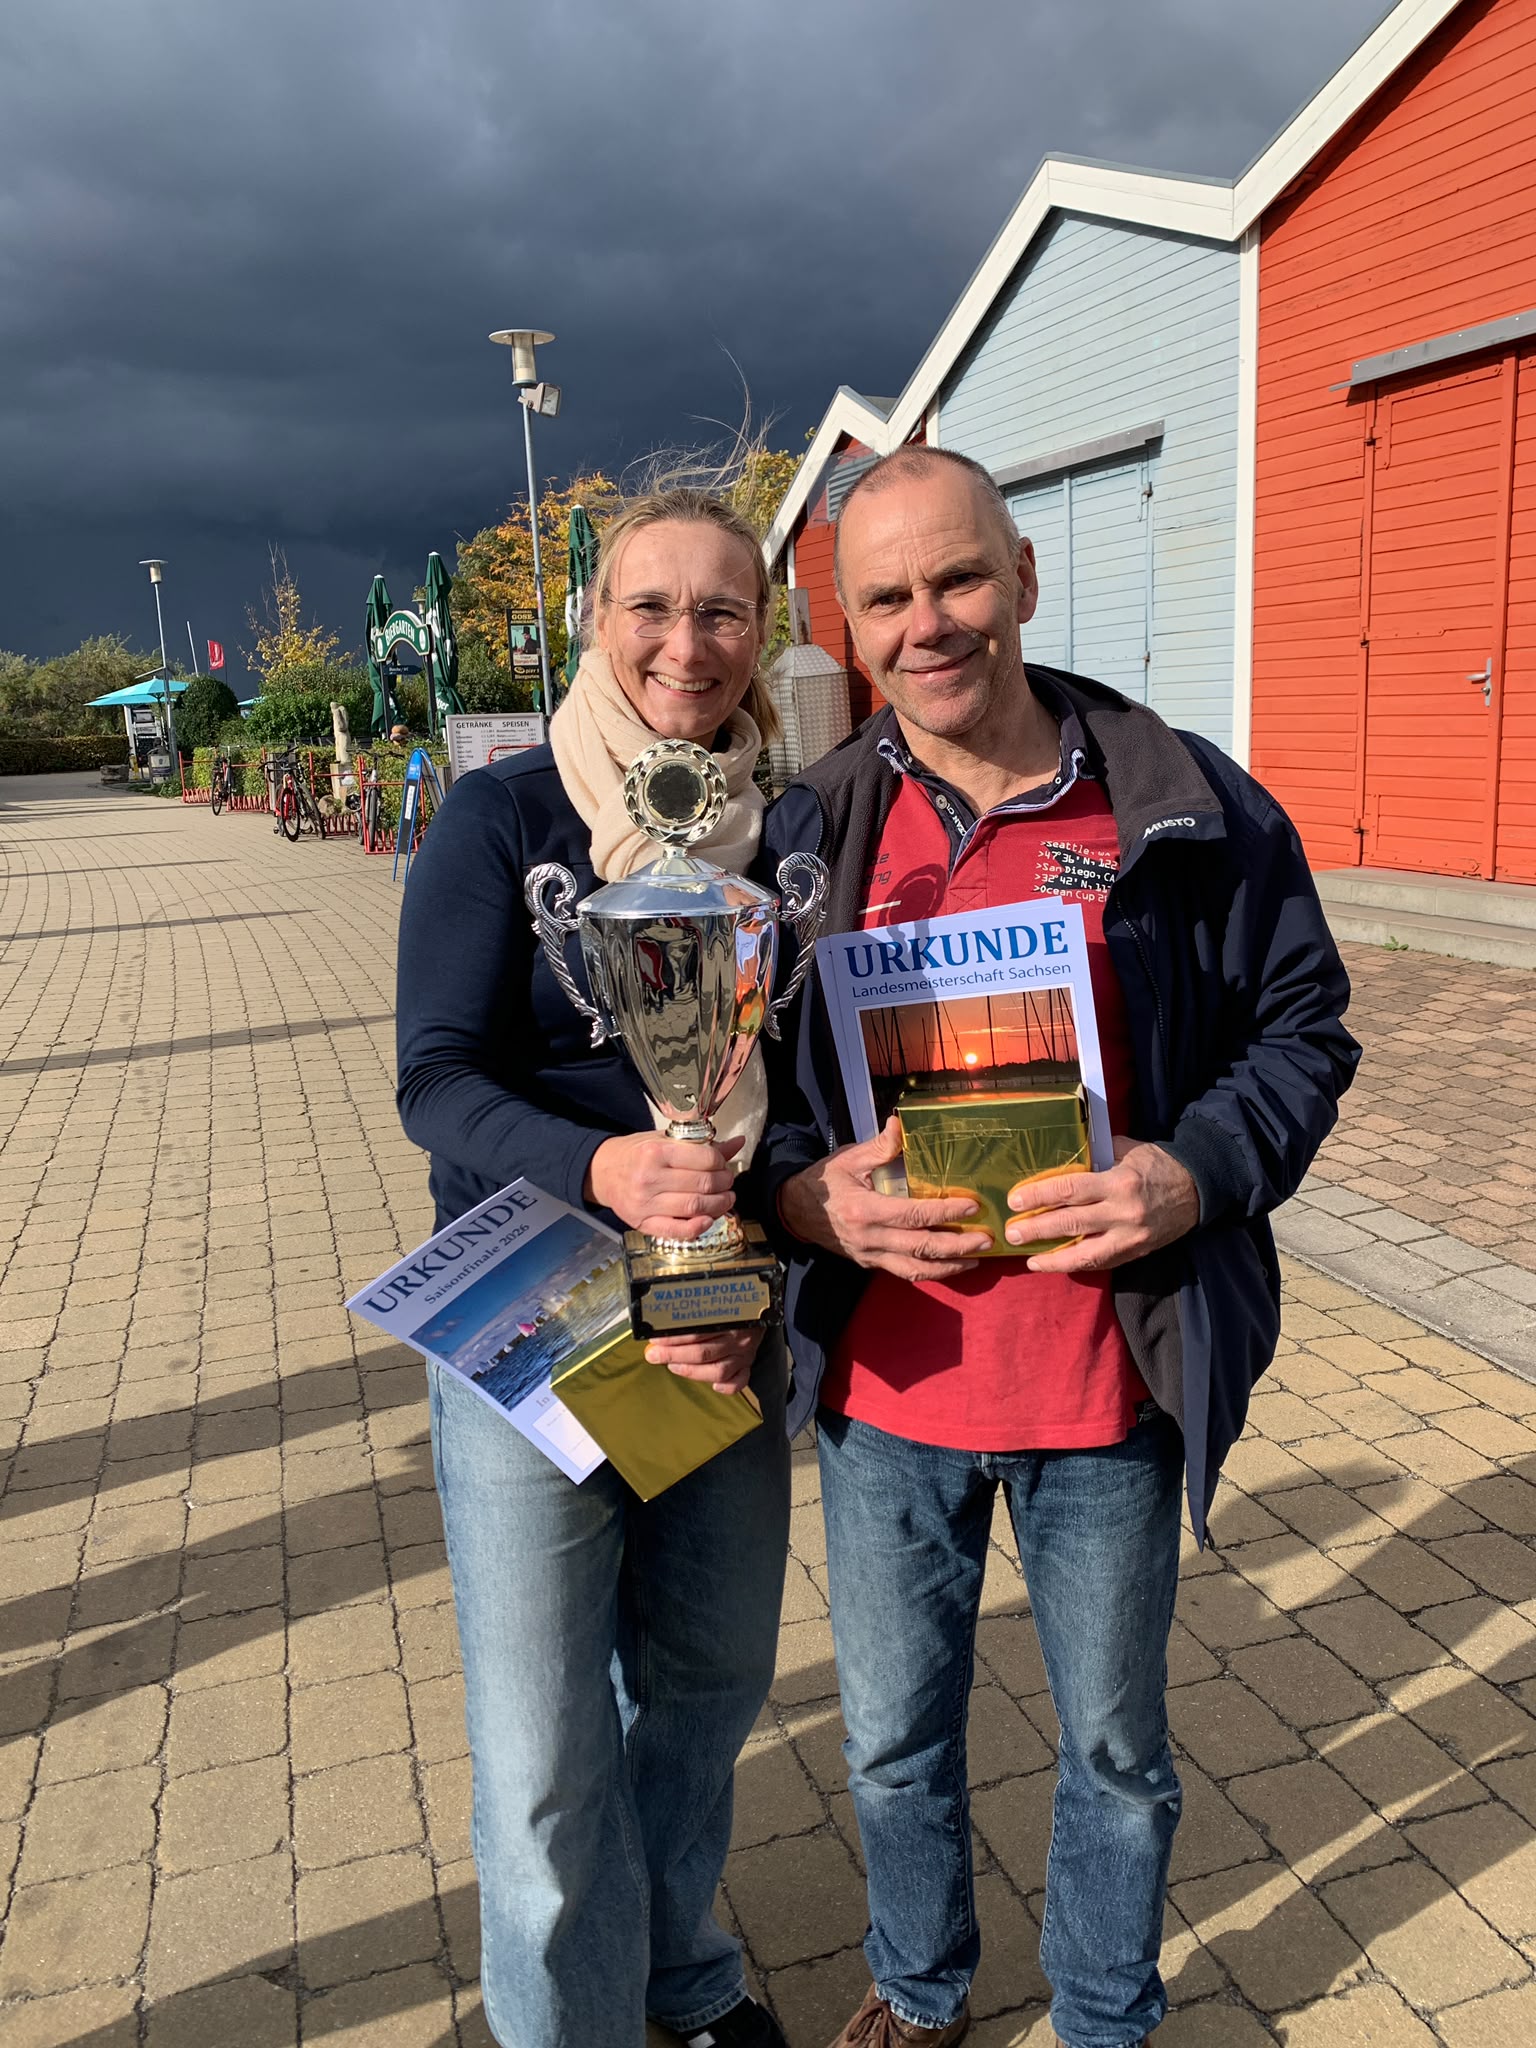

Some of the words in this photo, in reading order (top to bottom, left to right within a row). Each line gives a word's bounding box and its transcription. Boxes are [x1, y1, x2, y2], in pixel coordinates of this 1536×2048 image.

[385, 619, 415, 646] BIERGARTEN
[456, 720, 493, 729] GETRÄNKE
[502, 720, 530, 728] SPEISEN
[1142, 817, 1196, 840] MUSTO
[1075, 890, 1096, 903] Cup
[844, 920, 1069, 979] URKUNDE
[852, 969, 1005, 998] Landesmeisterschaft
[1008, 962, 1072, 980] Sachsen
[362, 1190, 538, 1313] URKUNDE
[424, 1245, 500, 1305] Saisonfinale
[500, 1223, 530, 1247] 2026
[653, 1281, 756, 1301] WANDERPOKAL
